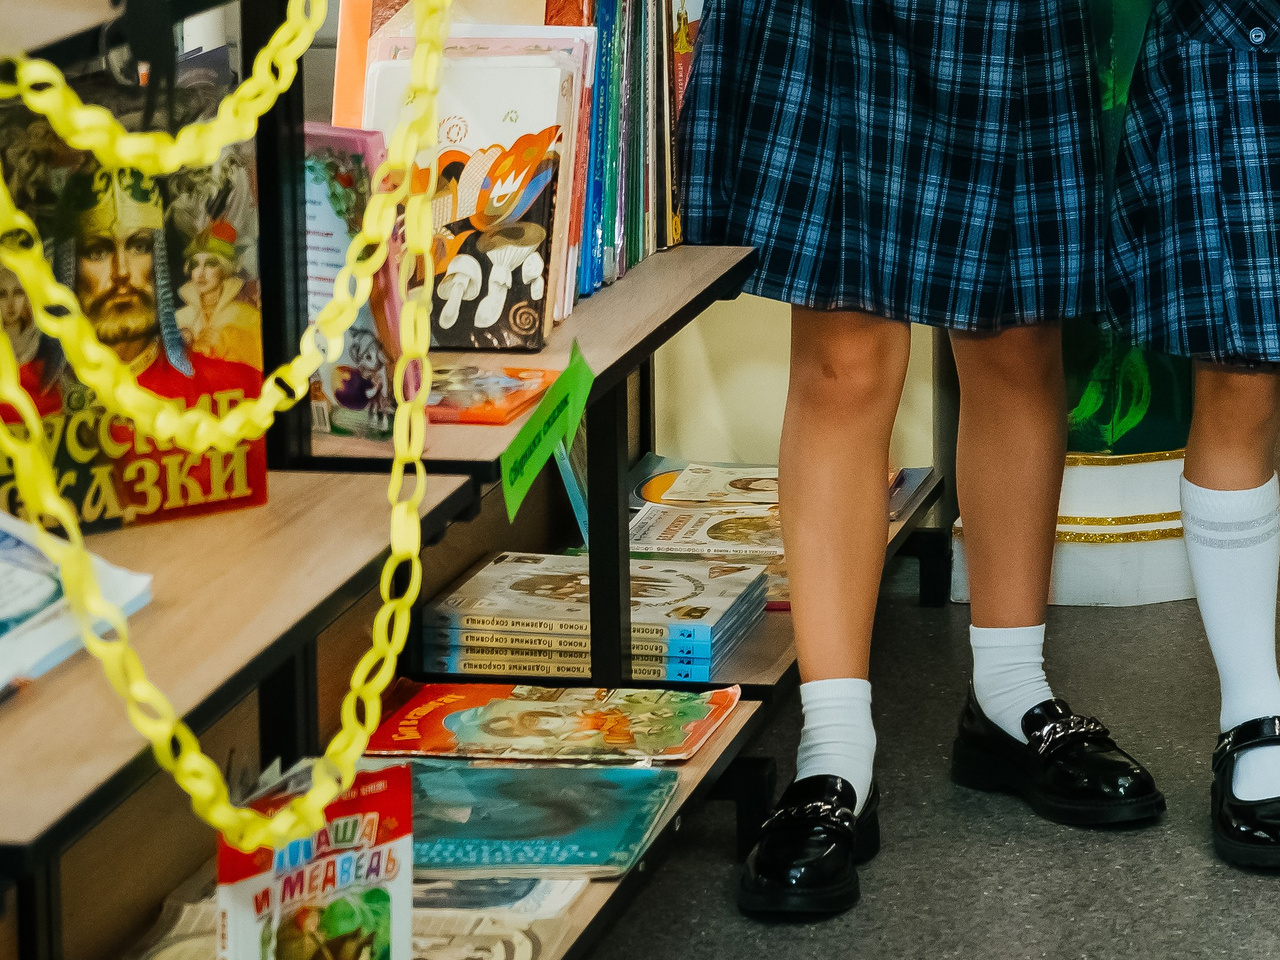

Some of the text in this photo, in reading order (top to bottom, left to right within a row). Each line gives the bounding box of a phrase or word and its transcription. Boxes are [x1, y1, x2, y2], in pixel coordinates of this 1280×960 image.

[465, 615, 509, 628] сокровища
[511, 620, 553, 630] Подземные
[632, 626, 664, 635] Белосне
[465, 632, 508, 645] сокровища
[510, 637, 552, 647] Подземные
[632, 643, 663, 652] Белосне
[463, 660, 506, 672] сокровища
[508, 663, 551, 674] Подземные
[275, 812, 380, 871] МАША
[281, 848, 400, 904] МЕДВЕДЬ
